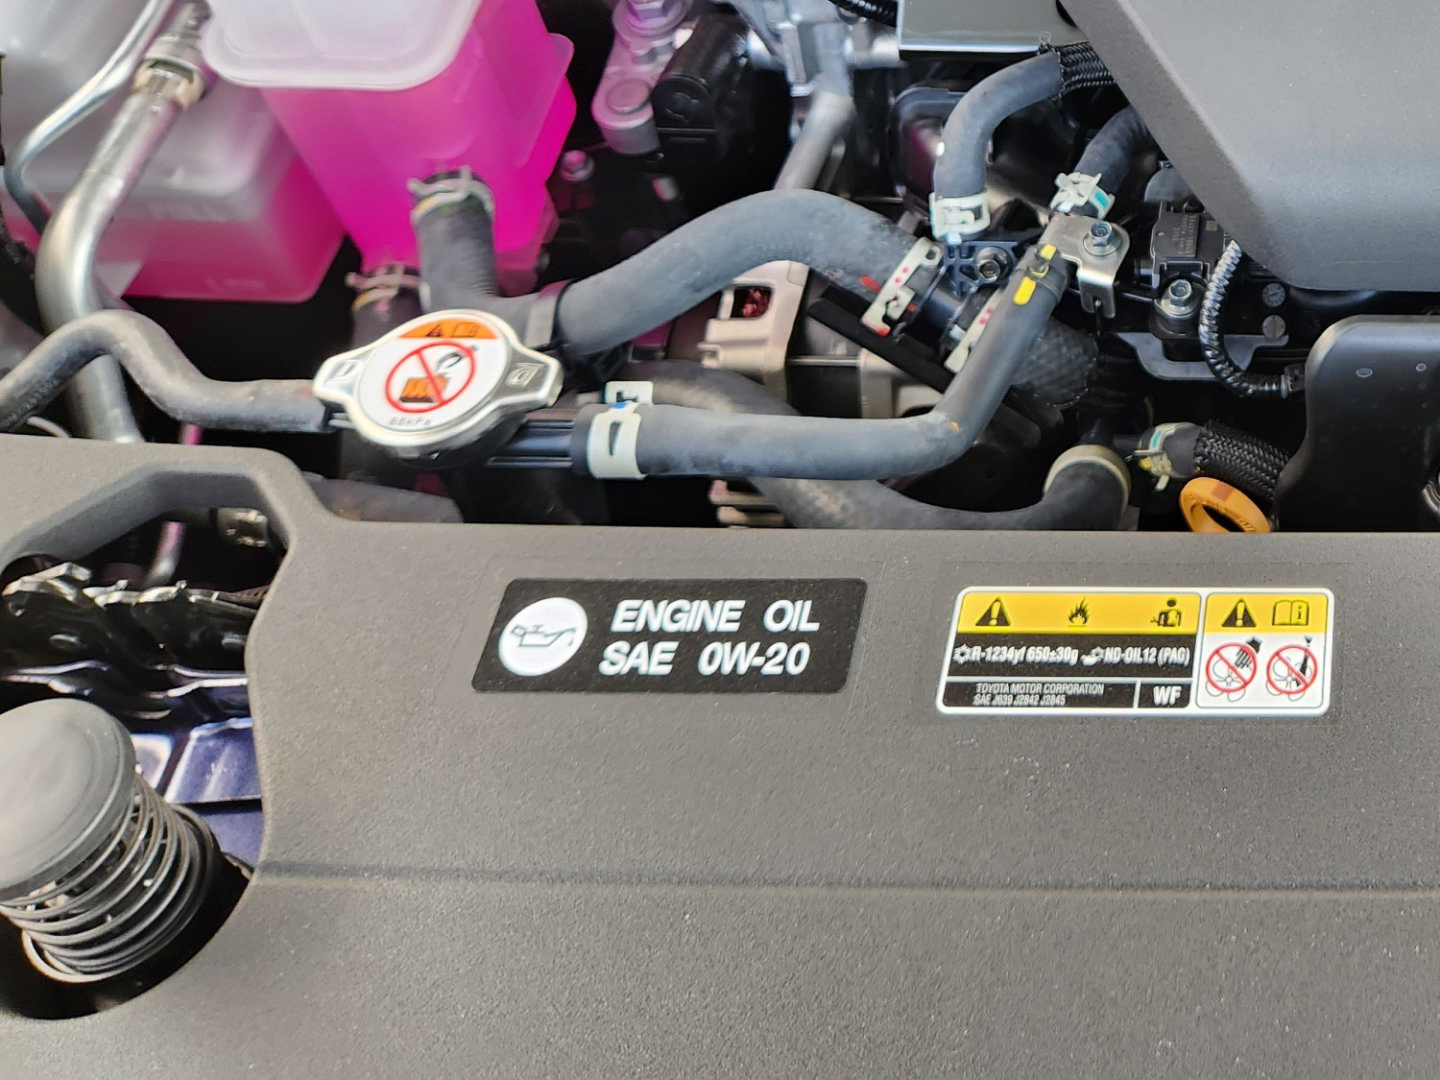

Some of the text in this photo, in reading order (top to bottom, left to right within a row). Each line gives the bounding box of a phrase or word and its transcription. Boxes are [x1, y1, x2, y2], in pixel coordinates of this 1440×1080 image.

[610, 599, 820, 632] ENGINE OIL
[599, 640, 810, 676] SAE 0W-20
[971, 646, 1079, 666] R-1234yf 650±30g
[1158, 647, 1190, 666] (PAG)
[975, 683, 1104, 695] TOYOTA MOTOR CORPORATION
[1153, 686, 1182, 705] WF
[973, 694, 991, 705] SAE
